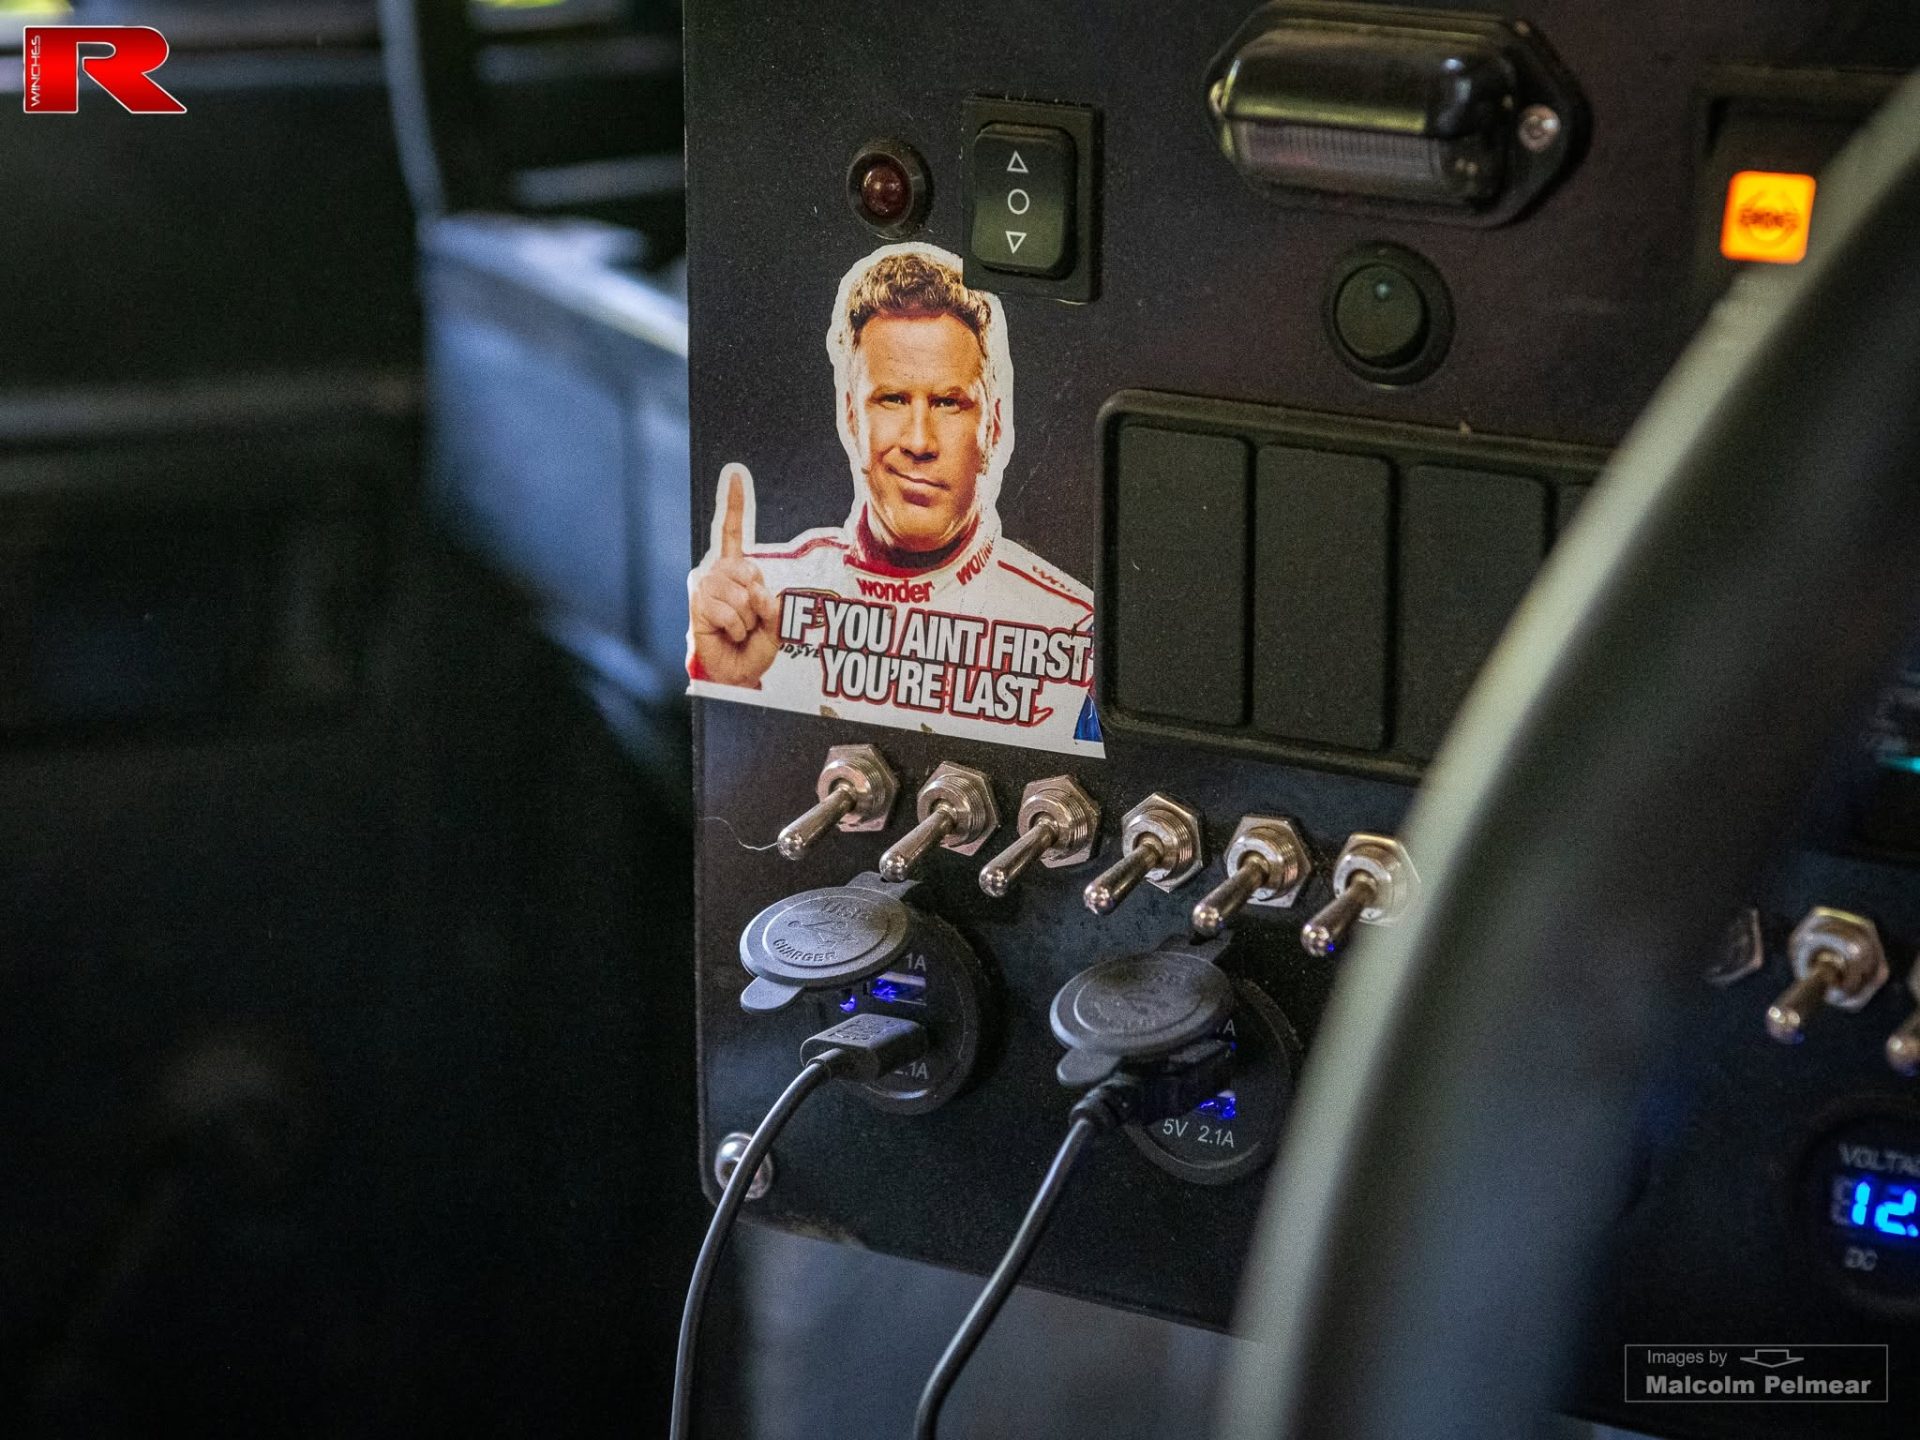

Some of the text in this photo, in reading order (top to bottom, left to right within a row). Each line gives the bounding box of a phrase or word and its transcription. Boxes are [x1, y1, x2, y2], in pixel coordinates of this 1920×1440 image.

[855, 577, 935, 603] wonder
[779, 593, 1093, 682] IF YOU AINT FIRST
[822, 647, 1038, 724] YOU'RE LAST
[773, 938, 837, 962] CHARGER
[893, 1061, 928, 1080] .1A
[1162, 1118, 1235, 1149] 5V 2.1A
[1846, 1247, 1878, 1271] DC
